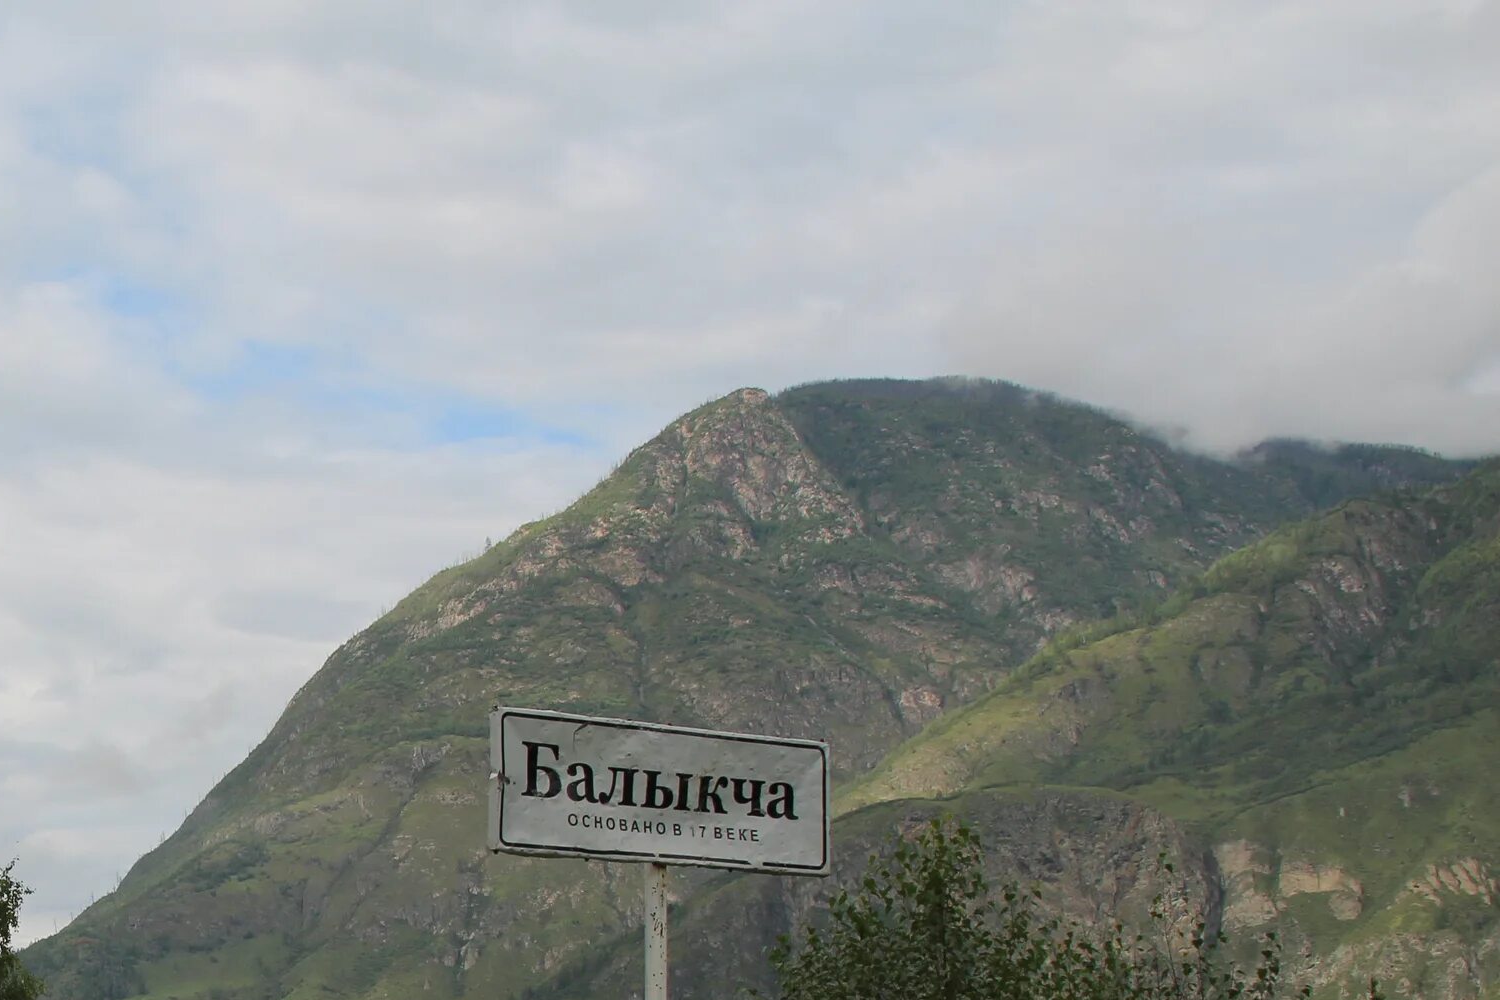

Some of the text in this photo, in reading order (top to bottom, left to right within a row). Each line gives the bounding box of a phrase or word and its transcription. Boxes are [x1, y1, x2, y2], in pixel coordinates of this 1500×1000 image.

[521, 741, 799, 820] Балыкча
[567, 813, 666, 835] ОСНОВАНО
[673, 823, 682, 836] В
[714, 827, 759, 842] ВЕКЕ
